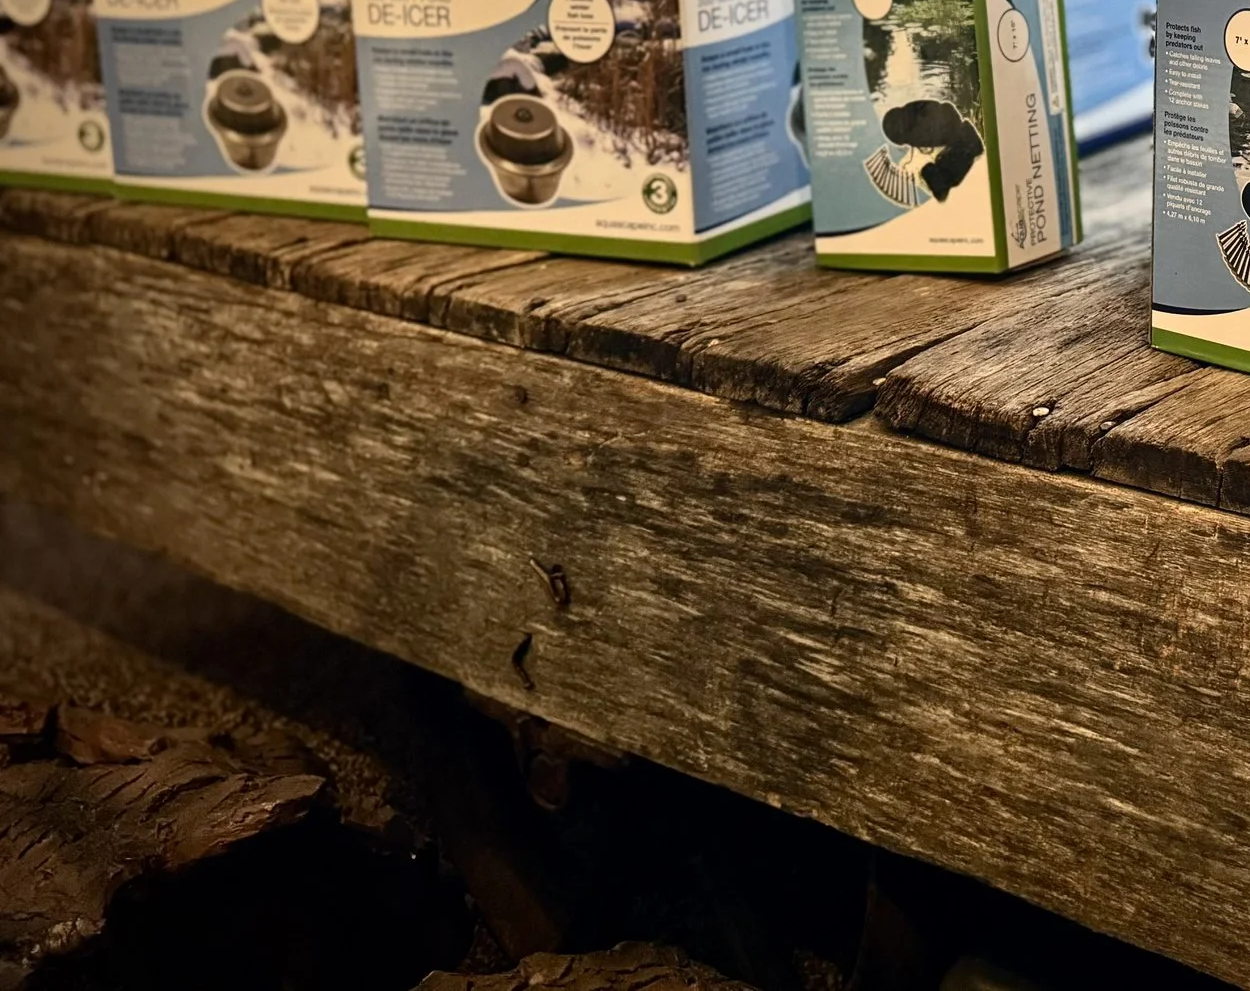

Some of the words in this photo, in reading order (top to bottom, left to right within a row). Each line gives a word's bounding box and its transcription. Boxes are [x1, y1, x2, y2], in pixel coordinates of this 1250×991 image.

[367, 3, 451, 28] DE-ICER
[1165, 22, 1189, 32] Protects
[1173, 32, 1196, 43] keeping
[1165, 40, 1192, 50] predators
[1164, 111, 1187, 122] Protège
[1164, 120, 1189, 131] poissons
[1025, 93, 1042, 180] NETTING
[1173, 130, 1204, 141] prédateurs
[650, 180, 668, 205] 3
[1025, 178, 1037, 246] PROTECTIVE
[1033, 185, 1048, 243] POND
